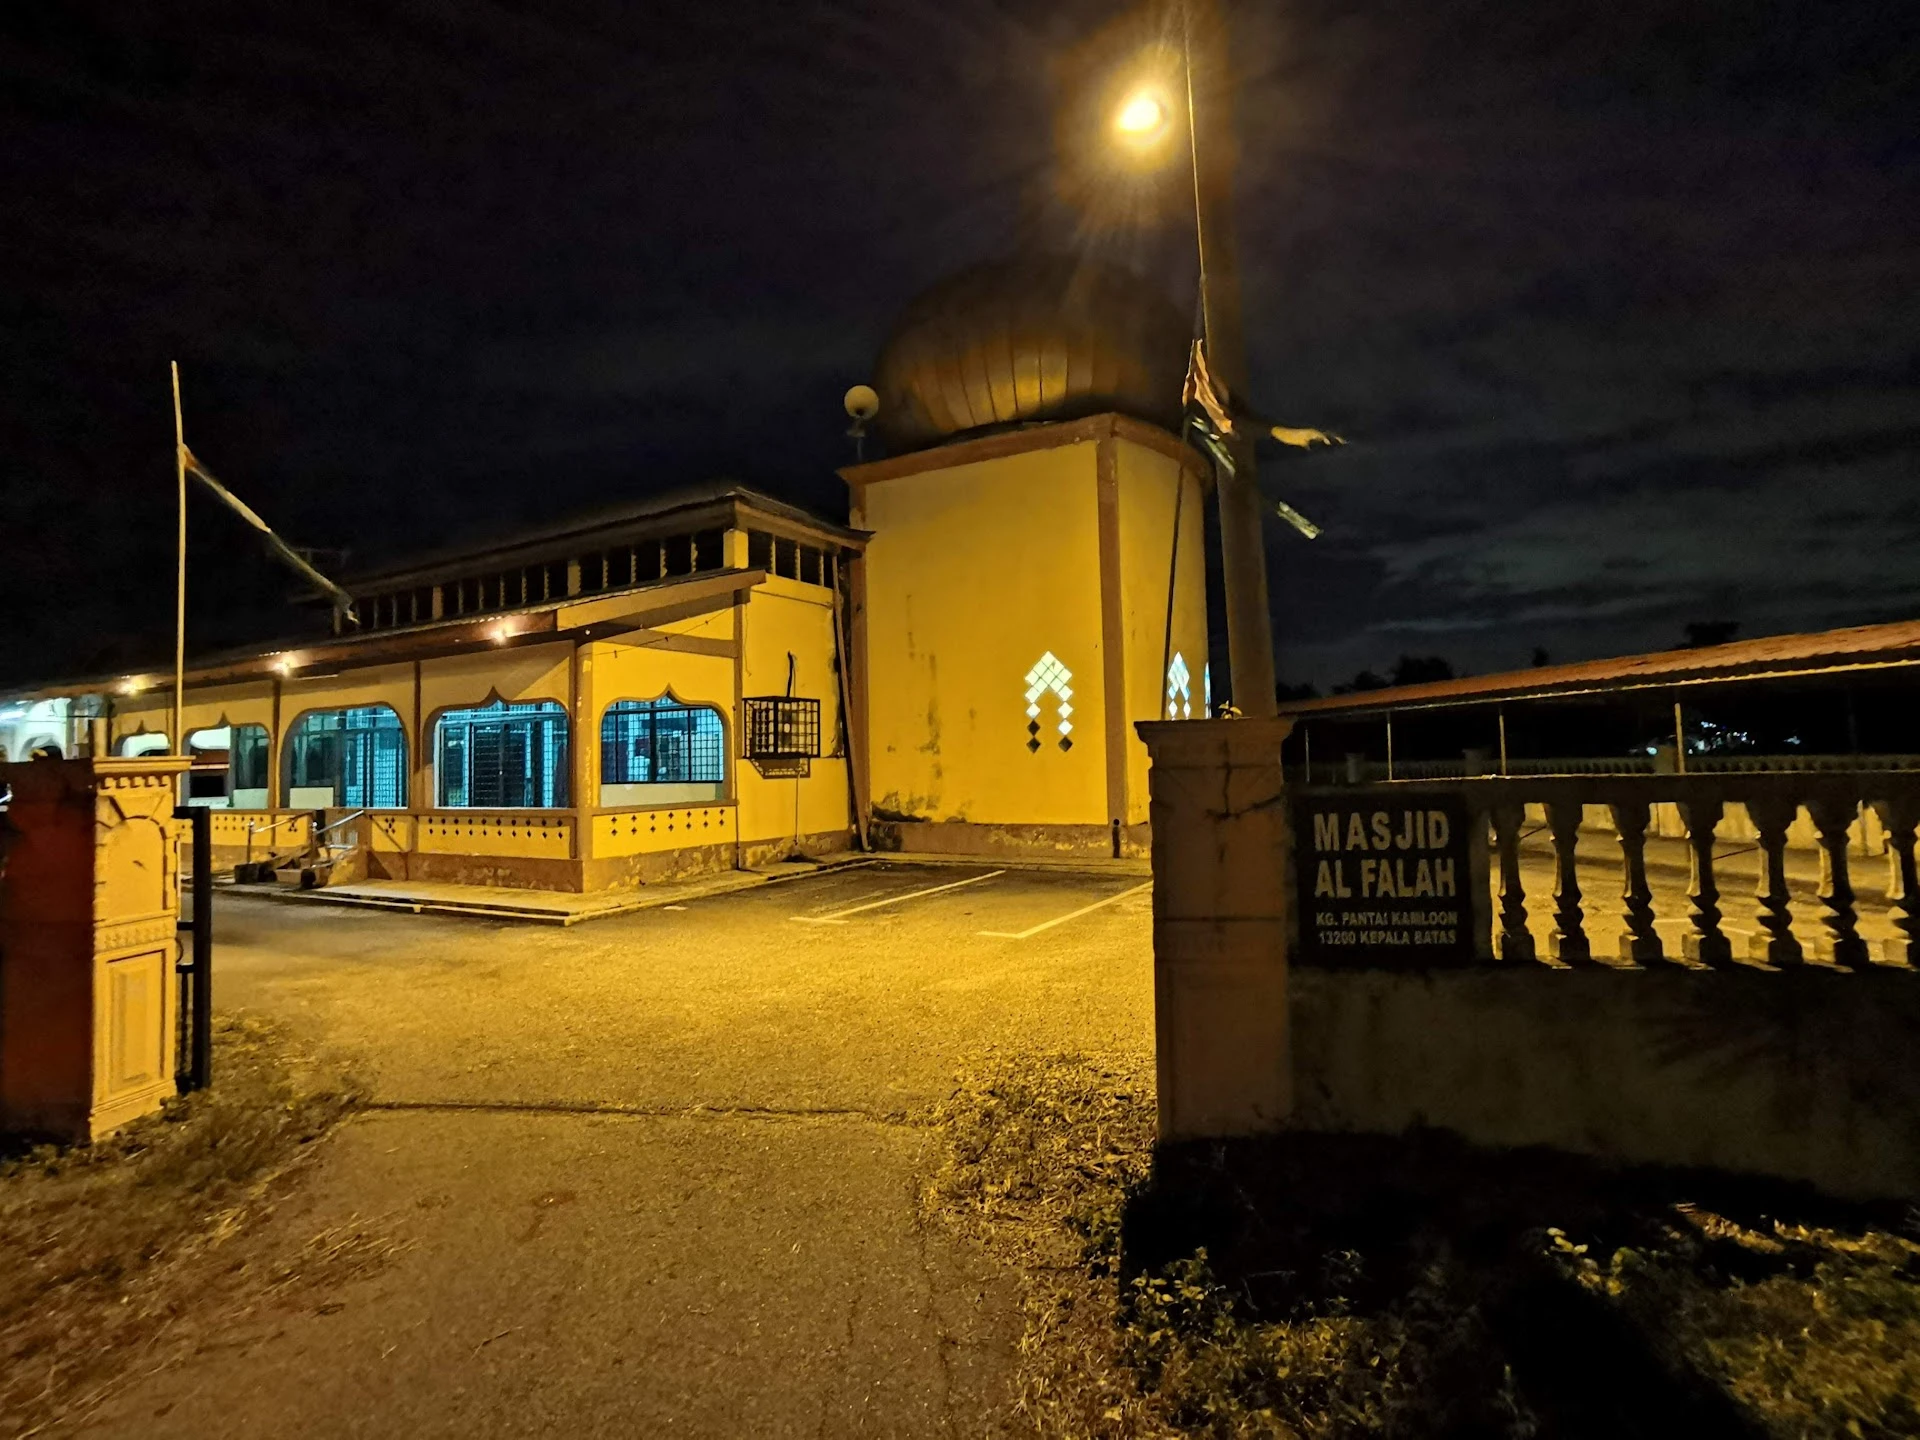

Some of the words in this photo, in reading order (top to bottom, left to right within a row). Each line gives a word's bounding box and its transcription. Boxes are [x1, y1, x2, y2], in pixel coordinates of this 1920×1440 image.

[1314, 810, 1450, 851] MASJID
[1314, 859, 1352, 898] AL
[1361, 858, 1456, 898] FALAH
[1316, 911, 1340, 926] KG.
[1342, 911, 1389, 926] PANTAI
[1360, 931, 1411, 945] KEPALA
[1413, 931, 1457, 945] BATAS
